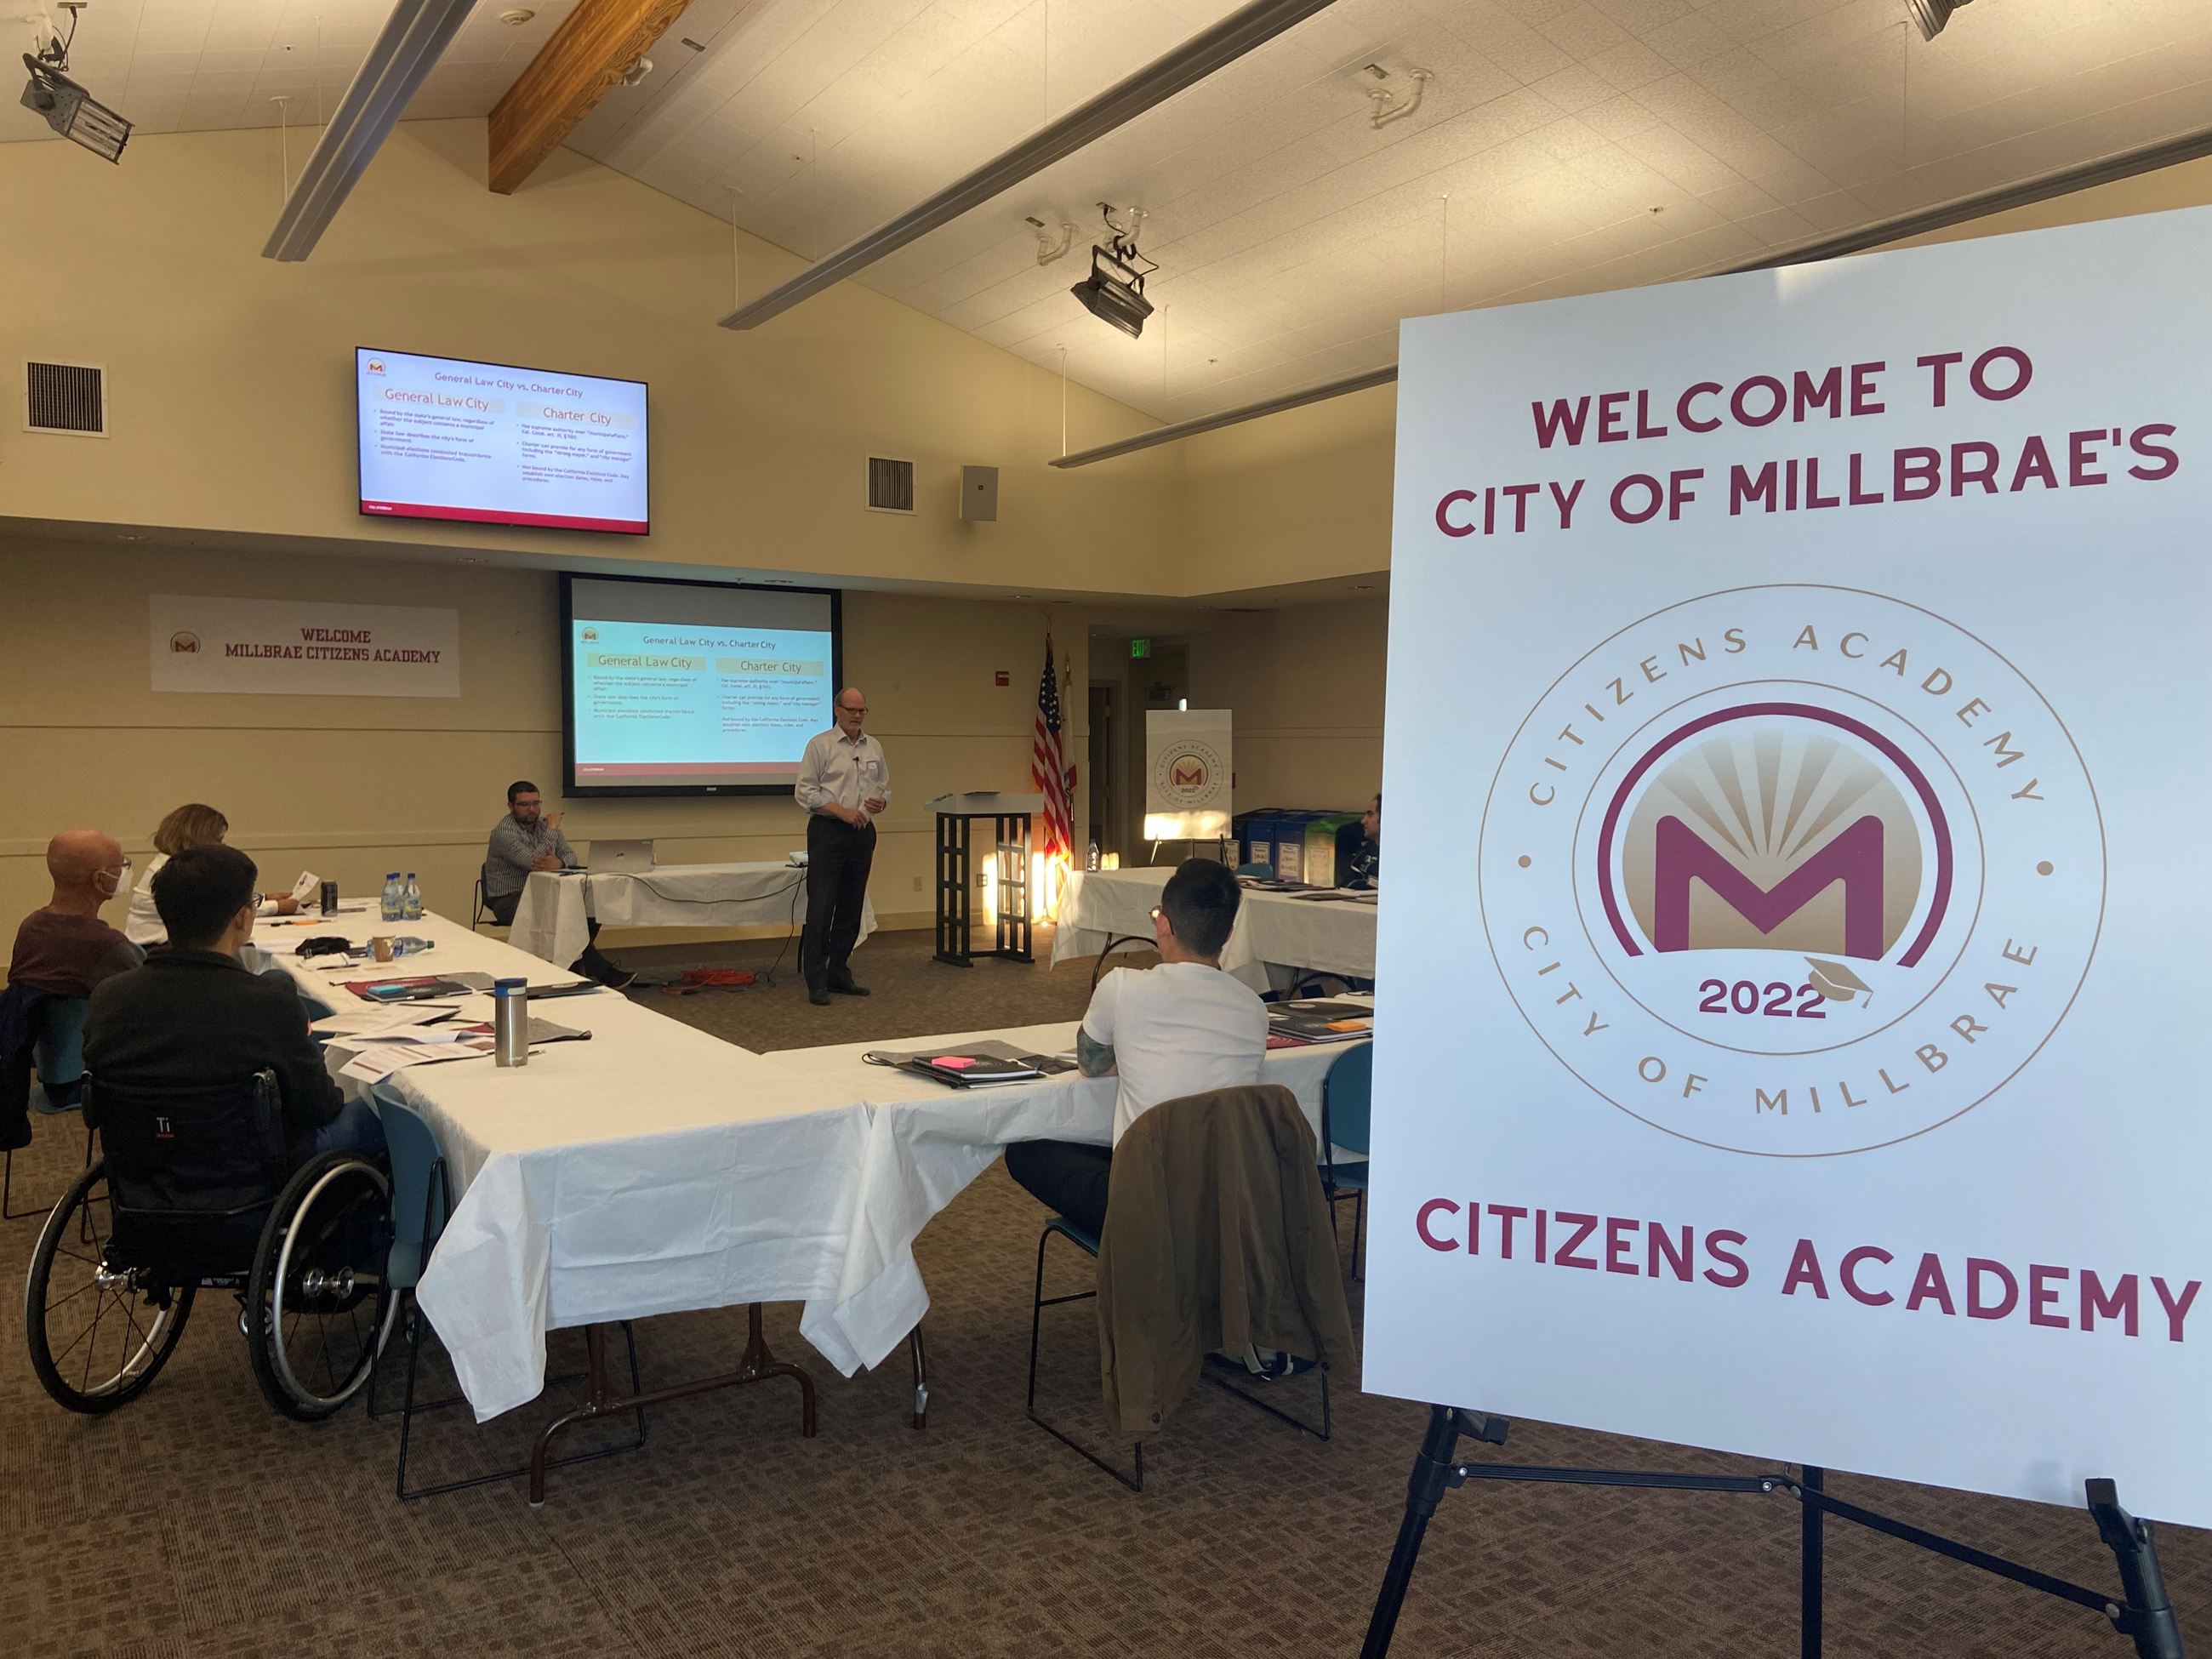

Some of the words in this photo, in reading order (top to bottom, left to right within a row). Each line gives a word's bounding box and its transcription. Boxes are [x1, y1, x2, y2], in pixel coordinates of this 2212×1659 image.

[435, 373, 472, 384] General
[476, 377, 493, 386] Law
[497, 379, 515, 391] City
[531, 384, 564, 395] Charter
[567, 388, 583, 398] City
[1531, 361, 1885, 448] WELCOME
[1917, 346, 2032, 408] TO
[385, 388, 433, 404] General
[438, 395, 463, 407] Law
[466, 396, 489, 412] City
[544, 407, 584, 421] Charter
[590, 412, 612, 426] City
[1436, 480, 1585, 537] CITY
[1611, 469, 1704, 524] OF
[1730, 424, 2179, 516] MILLBRAE'S
[300, 628, 371, 643] WELCOME
[643, 636, 676, 645] General
[698, 638, 715, 647] City
[761, 641, 776, 650] City
[225, 643, 303, 658] MILLBRAE
[306, 647, 369, 661] CITIZENS
[374, 648, 441, 664] ACADEMY
[598, 655, 641, 666] General
[647, 657, 668, 667] Law
[671, 657, 692, 670] City
[740, 661, 777, 672] Charter
[783, 662, 801, 674] City
[1531, 629, 1746, 805] CITIZENS
[1793, 625, 2044, 801] ACADEMY
[1699, 979, 1826, 1019] 2022
[1524, 926, 1609, 1036] CITY
[1639, 1057, 1707, 1097] OF
[1756, 939, 2037, 1115] MILLBRAE
[157, 1116, 170, 1132] Ti
[1417, 1199, 1748, 1287] CITIZENS
[1782, 1239, 2202, 1342] ACADEMY
